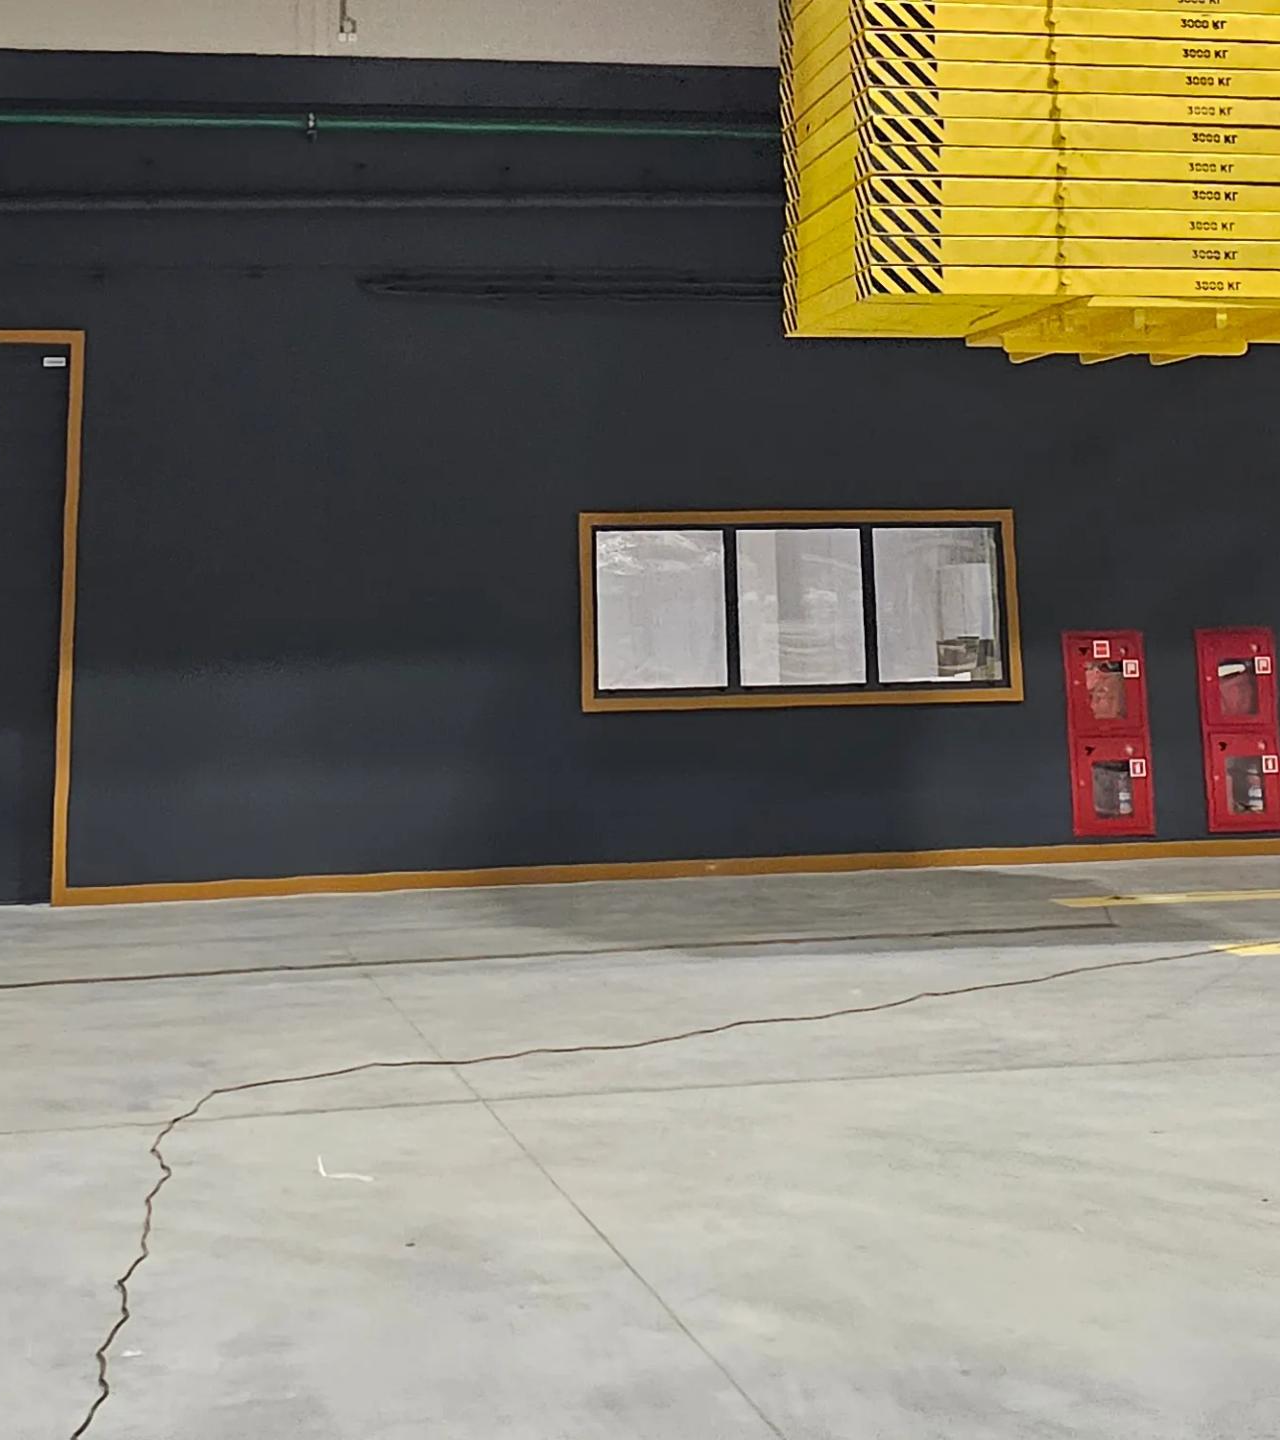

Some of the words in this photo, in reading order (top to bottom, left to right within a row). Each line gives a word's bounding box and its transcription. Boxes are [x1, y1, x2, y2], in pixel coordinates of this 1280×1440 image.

[1181, 18, 1209, 29] 3000
[1182, 48, 1210, 58] 3000
[1186, 76, 1214, 86] 3000
[1187, 106, 1215, 115] 3000
[1192, 132, 1220, 143] 3000
[1189, 162, 1216, 172] 3000
[1192, 190, 1220, 200] 3000
[1190, 221, 1218, 231] 3000
[1192, 249, 1220, 260] 3000
[1195, 281, 1224, 291] 3000
